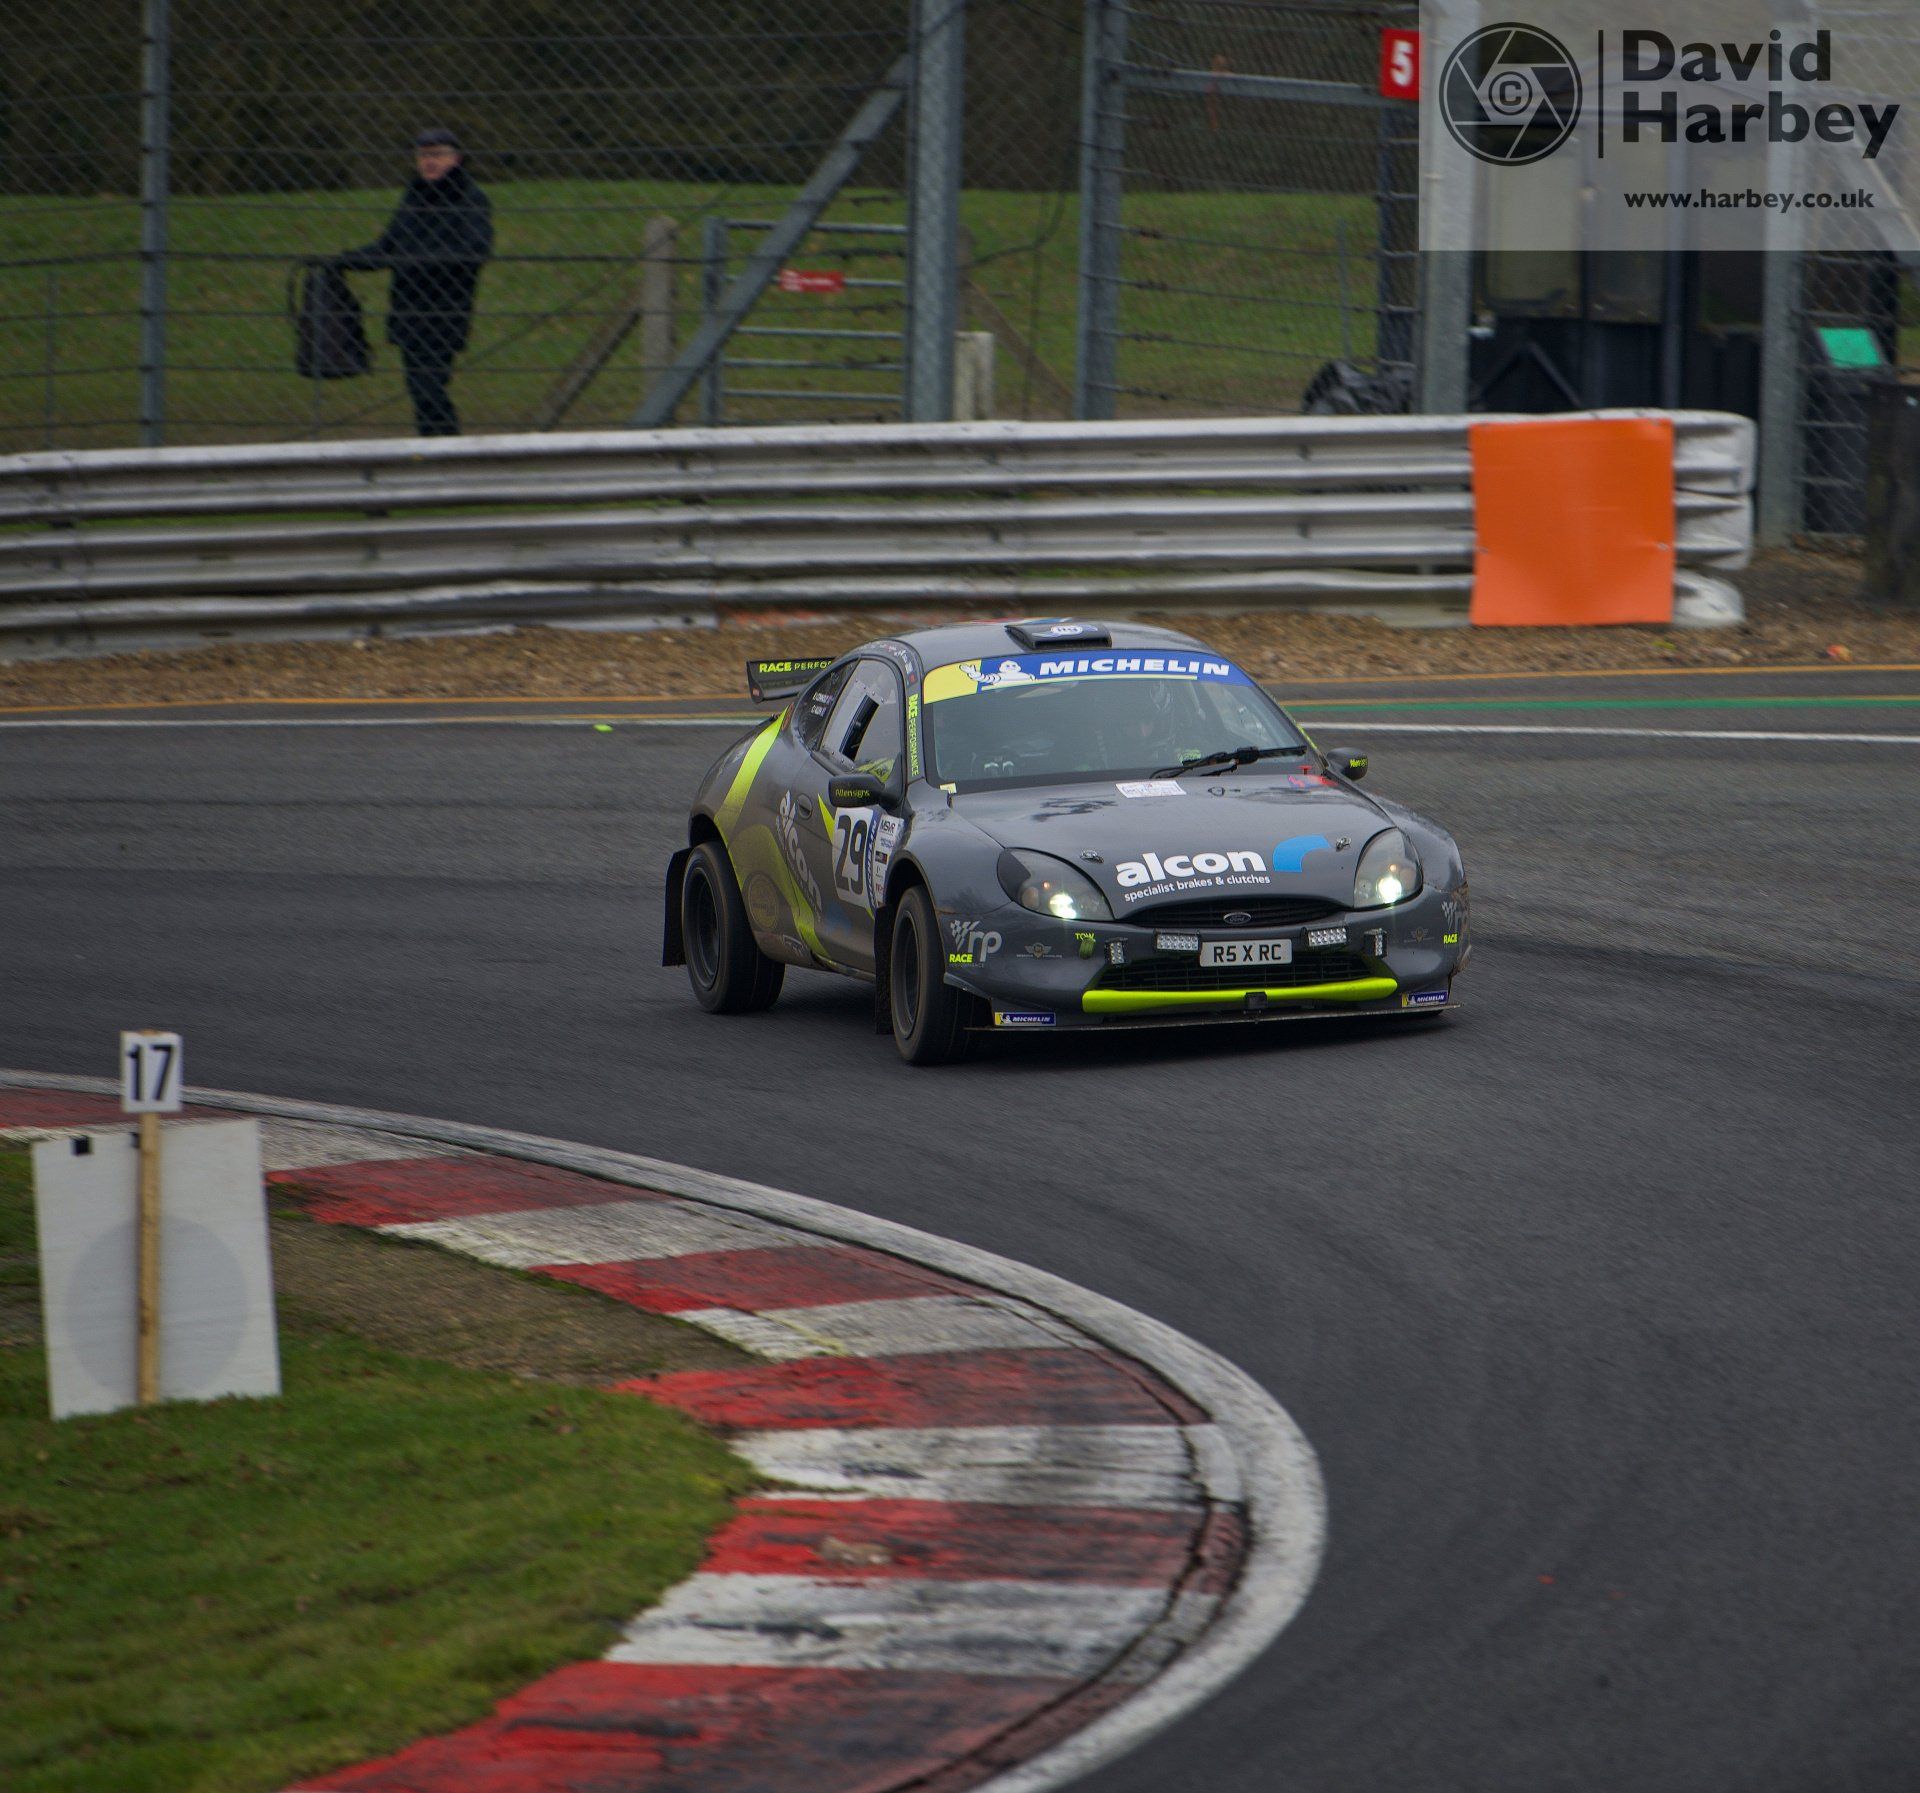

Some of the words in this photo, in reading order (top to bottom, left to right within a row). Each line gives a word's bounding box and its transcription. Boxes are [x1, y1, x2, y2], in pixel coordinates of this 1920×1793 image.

[1390, 39, 1414, 86] 5
[759, 661, 792, 673] RACE
[1039, 658, 1231, 676] MICHELIN
[908, 693, 919, 719] RACE
[835, 814, 868, 896] 29
[1115, 850, 1267, 887] alcon
[1124, 882, 1175, 902] specialist
[1176, 876, 1212, 890] brakes
[1215, 876, 1225, 885] &
[1227, 874, 1271, 884] clutches
[949, 954, 973, 963] RACE
[1213, 946, 1237, 963] R5
[1243, 945, 1253, 962] X
[1260, 944, 1282, 961] RC
[126, 1043, 174, 1102] 17
